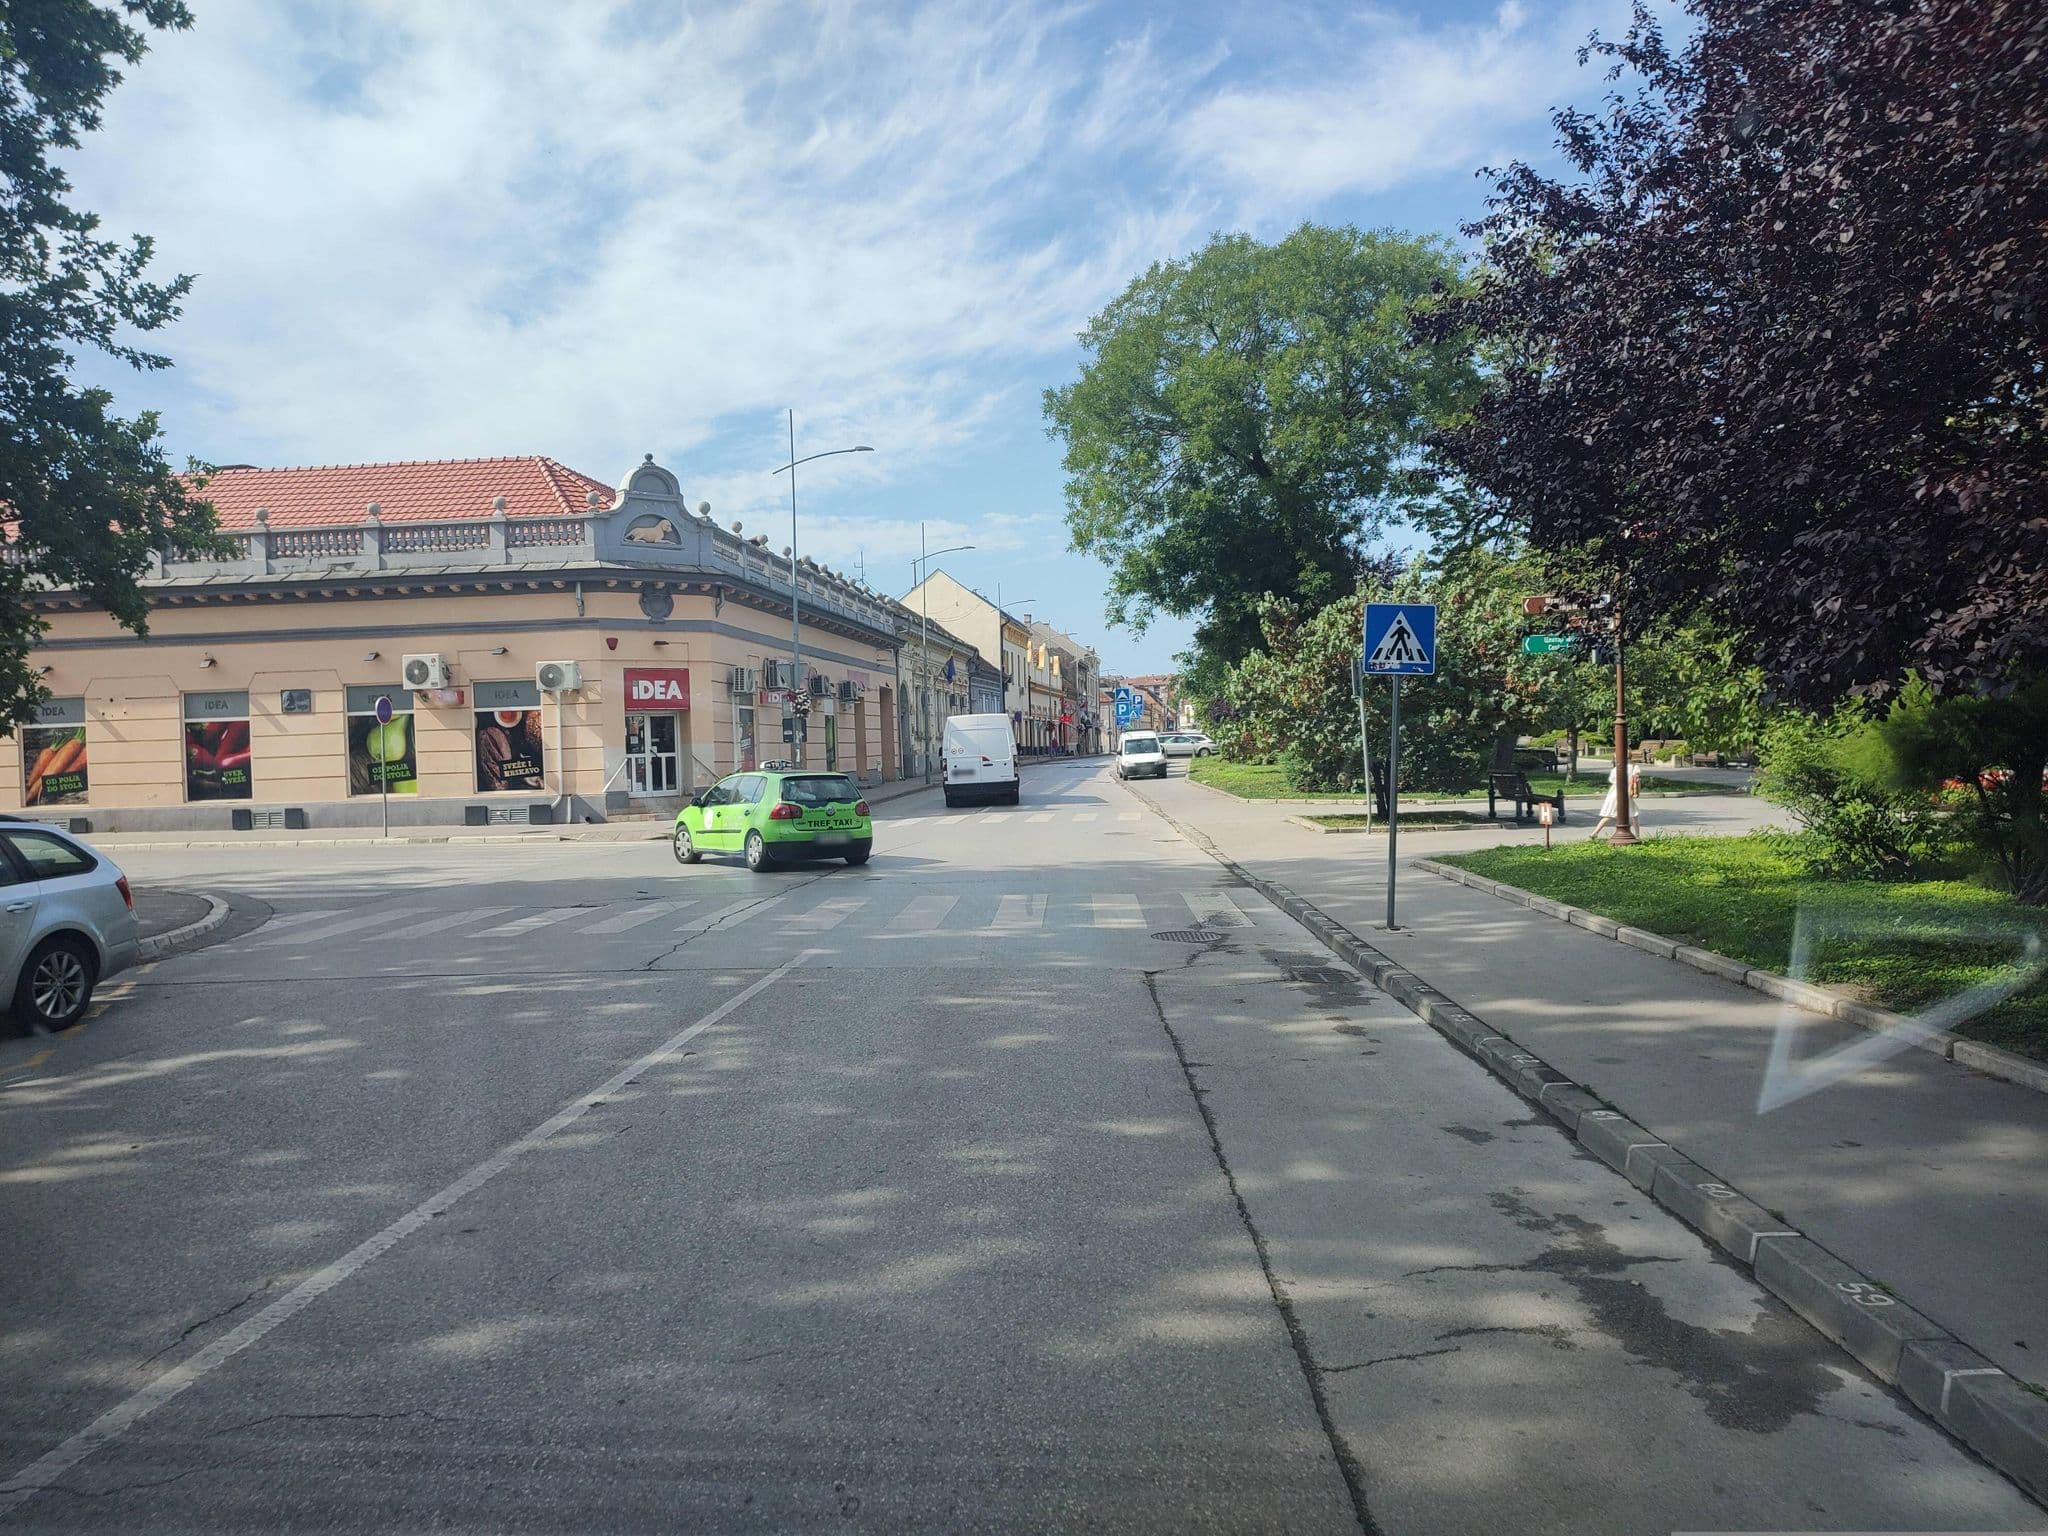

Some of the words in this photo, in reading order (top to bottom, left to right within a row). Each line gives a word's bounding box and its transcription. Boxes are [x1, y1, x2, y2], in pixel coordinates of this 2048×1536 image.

[1119, 704, 1127, 715] P
[808, 820, 831, 828] TREF
[1837, 1283, 1895, 1306] 59
